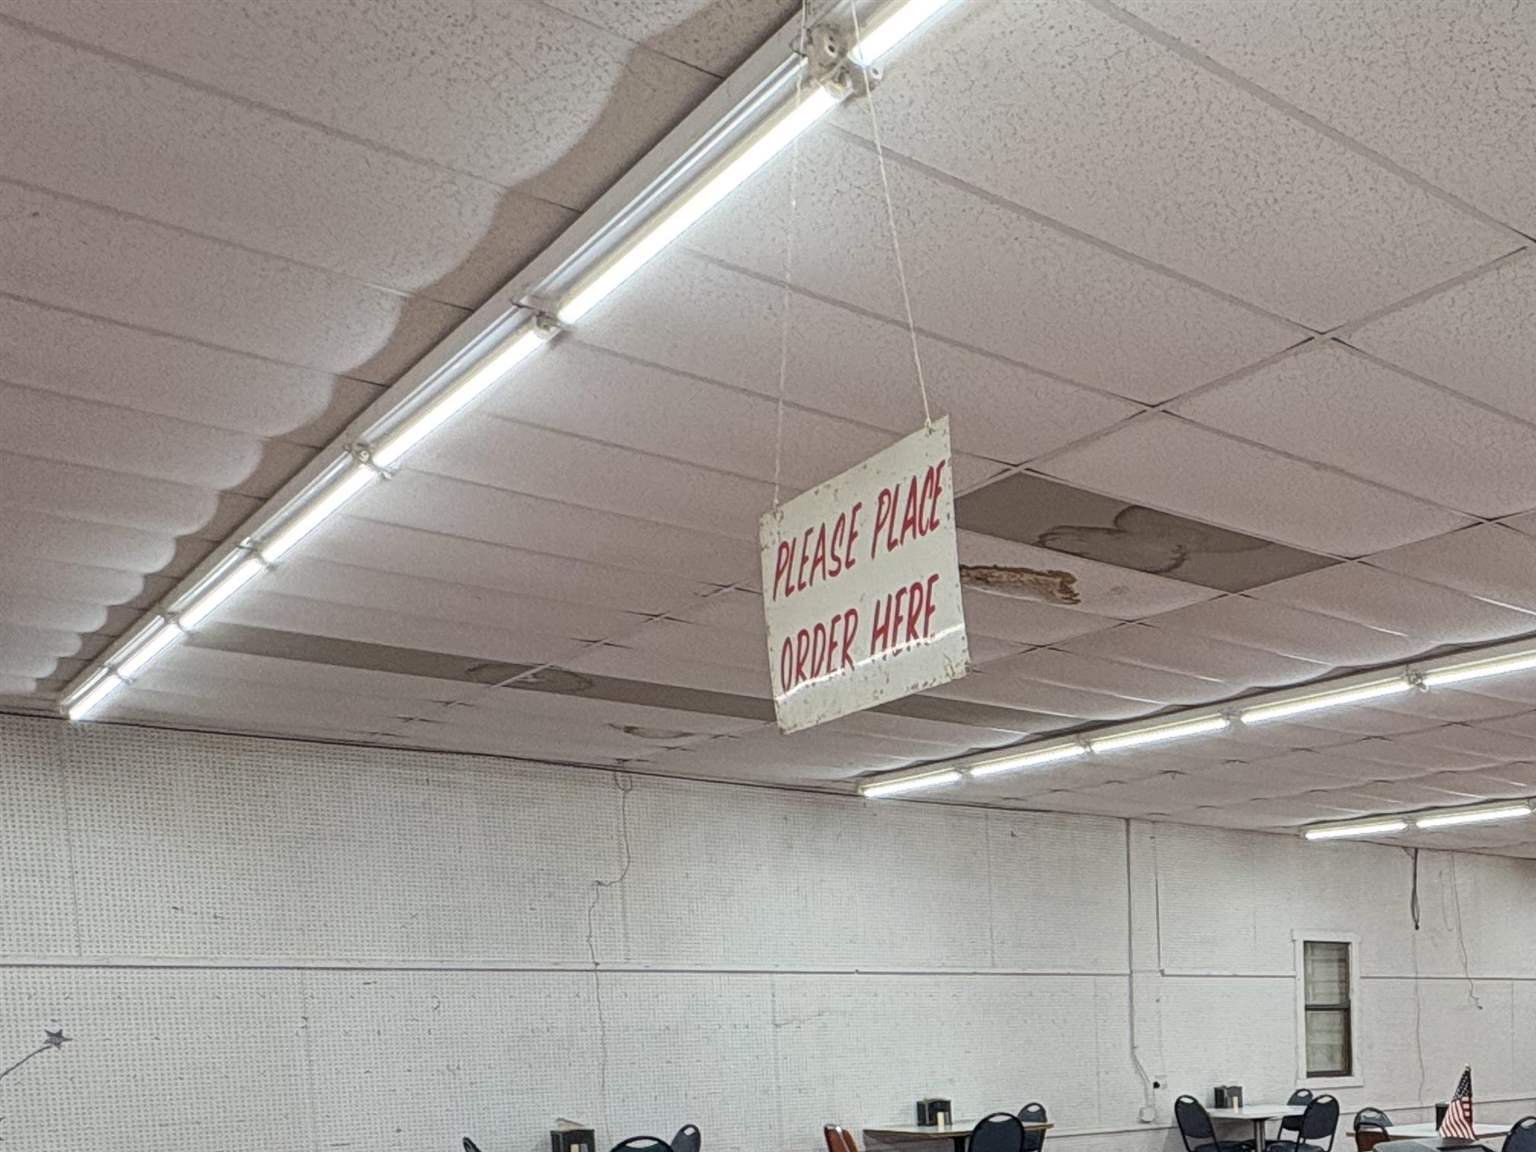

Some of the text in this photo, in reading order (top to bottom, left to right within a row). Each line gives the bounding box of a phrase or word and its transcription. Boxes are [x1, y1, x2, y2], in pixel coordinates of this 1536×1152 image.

[772, 459, 946, 601] PLEASE PLACE
[780, 573, 939, 694] ORDER HERE
